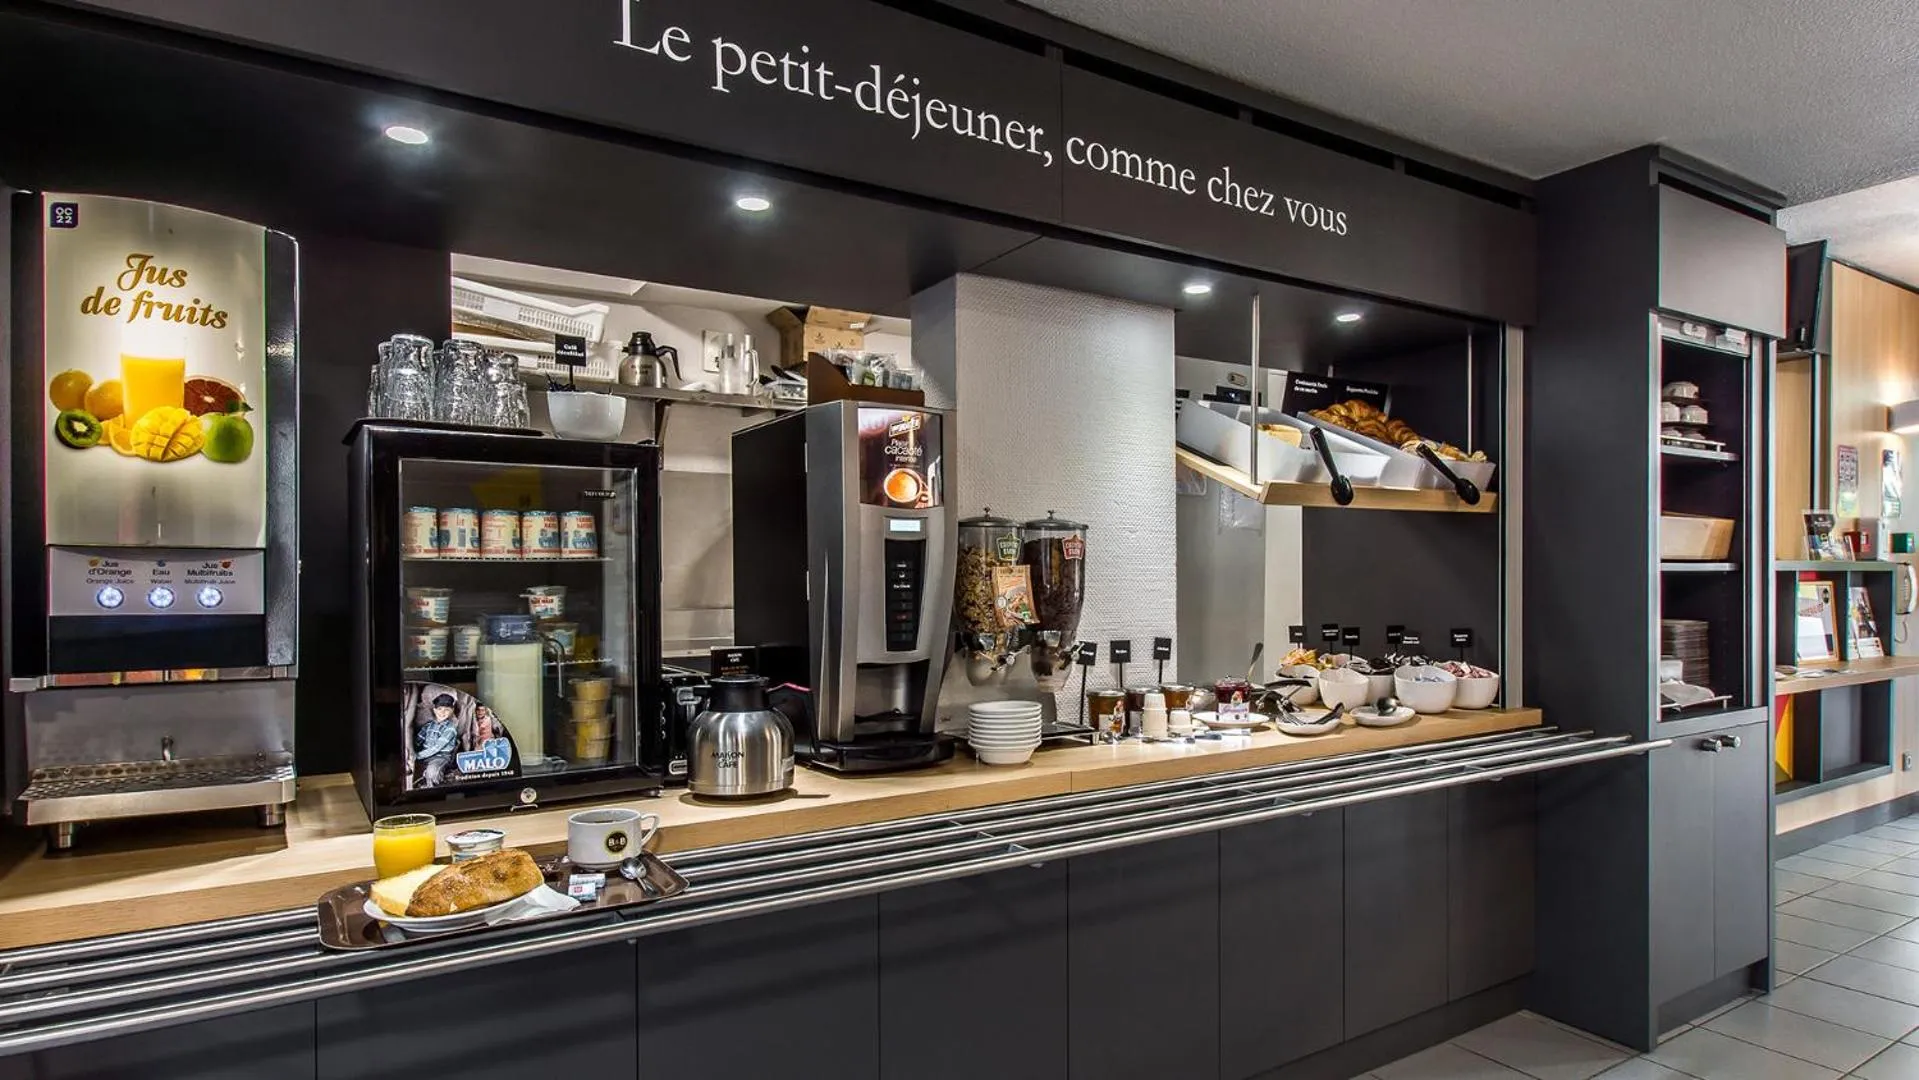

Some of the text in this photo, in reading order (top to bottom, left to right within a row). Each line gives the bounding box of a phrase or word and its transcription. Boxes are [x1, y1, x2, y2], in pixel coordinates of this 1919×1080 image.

[612, 0, 1348, 237] Le petit-déjeuner, comme chez vous
[55, 215, 73, 224] 22
[117, 253, 188, 291] Jus
[80, 286, 229, 330] de fruits
[464, 757, 506, 771] MALO
